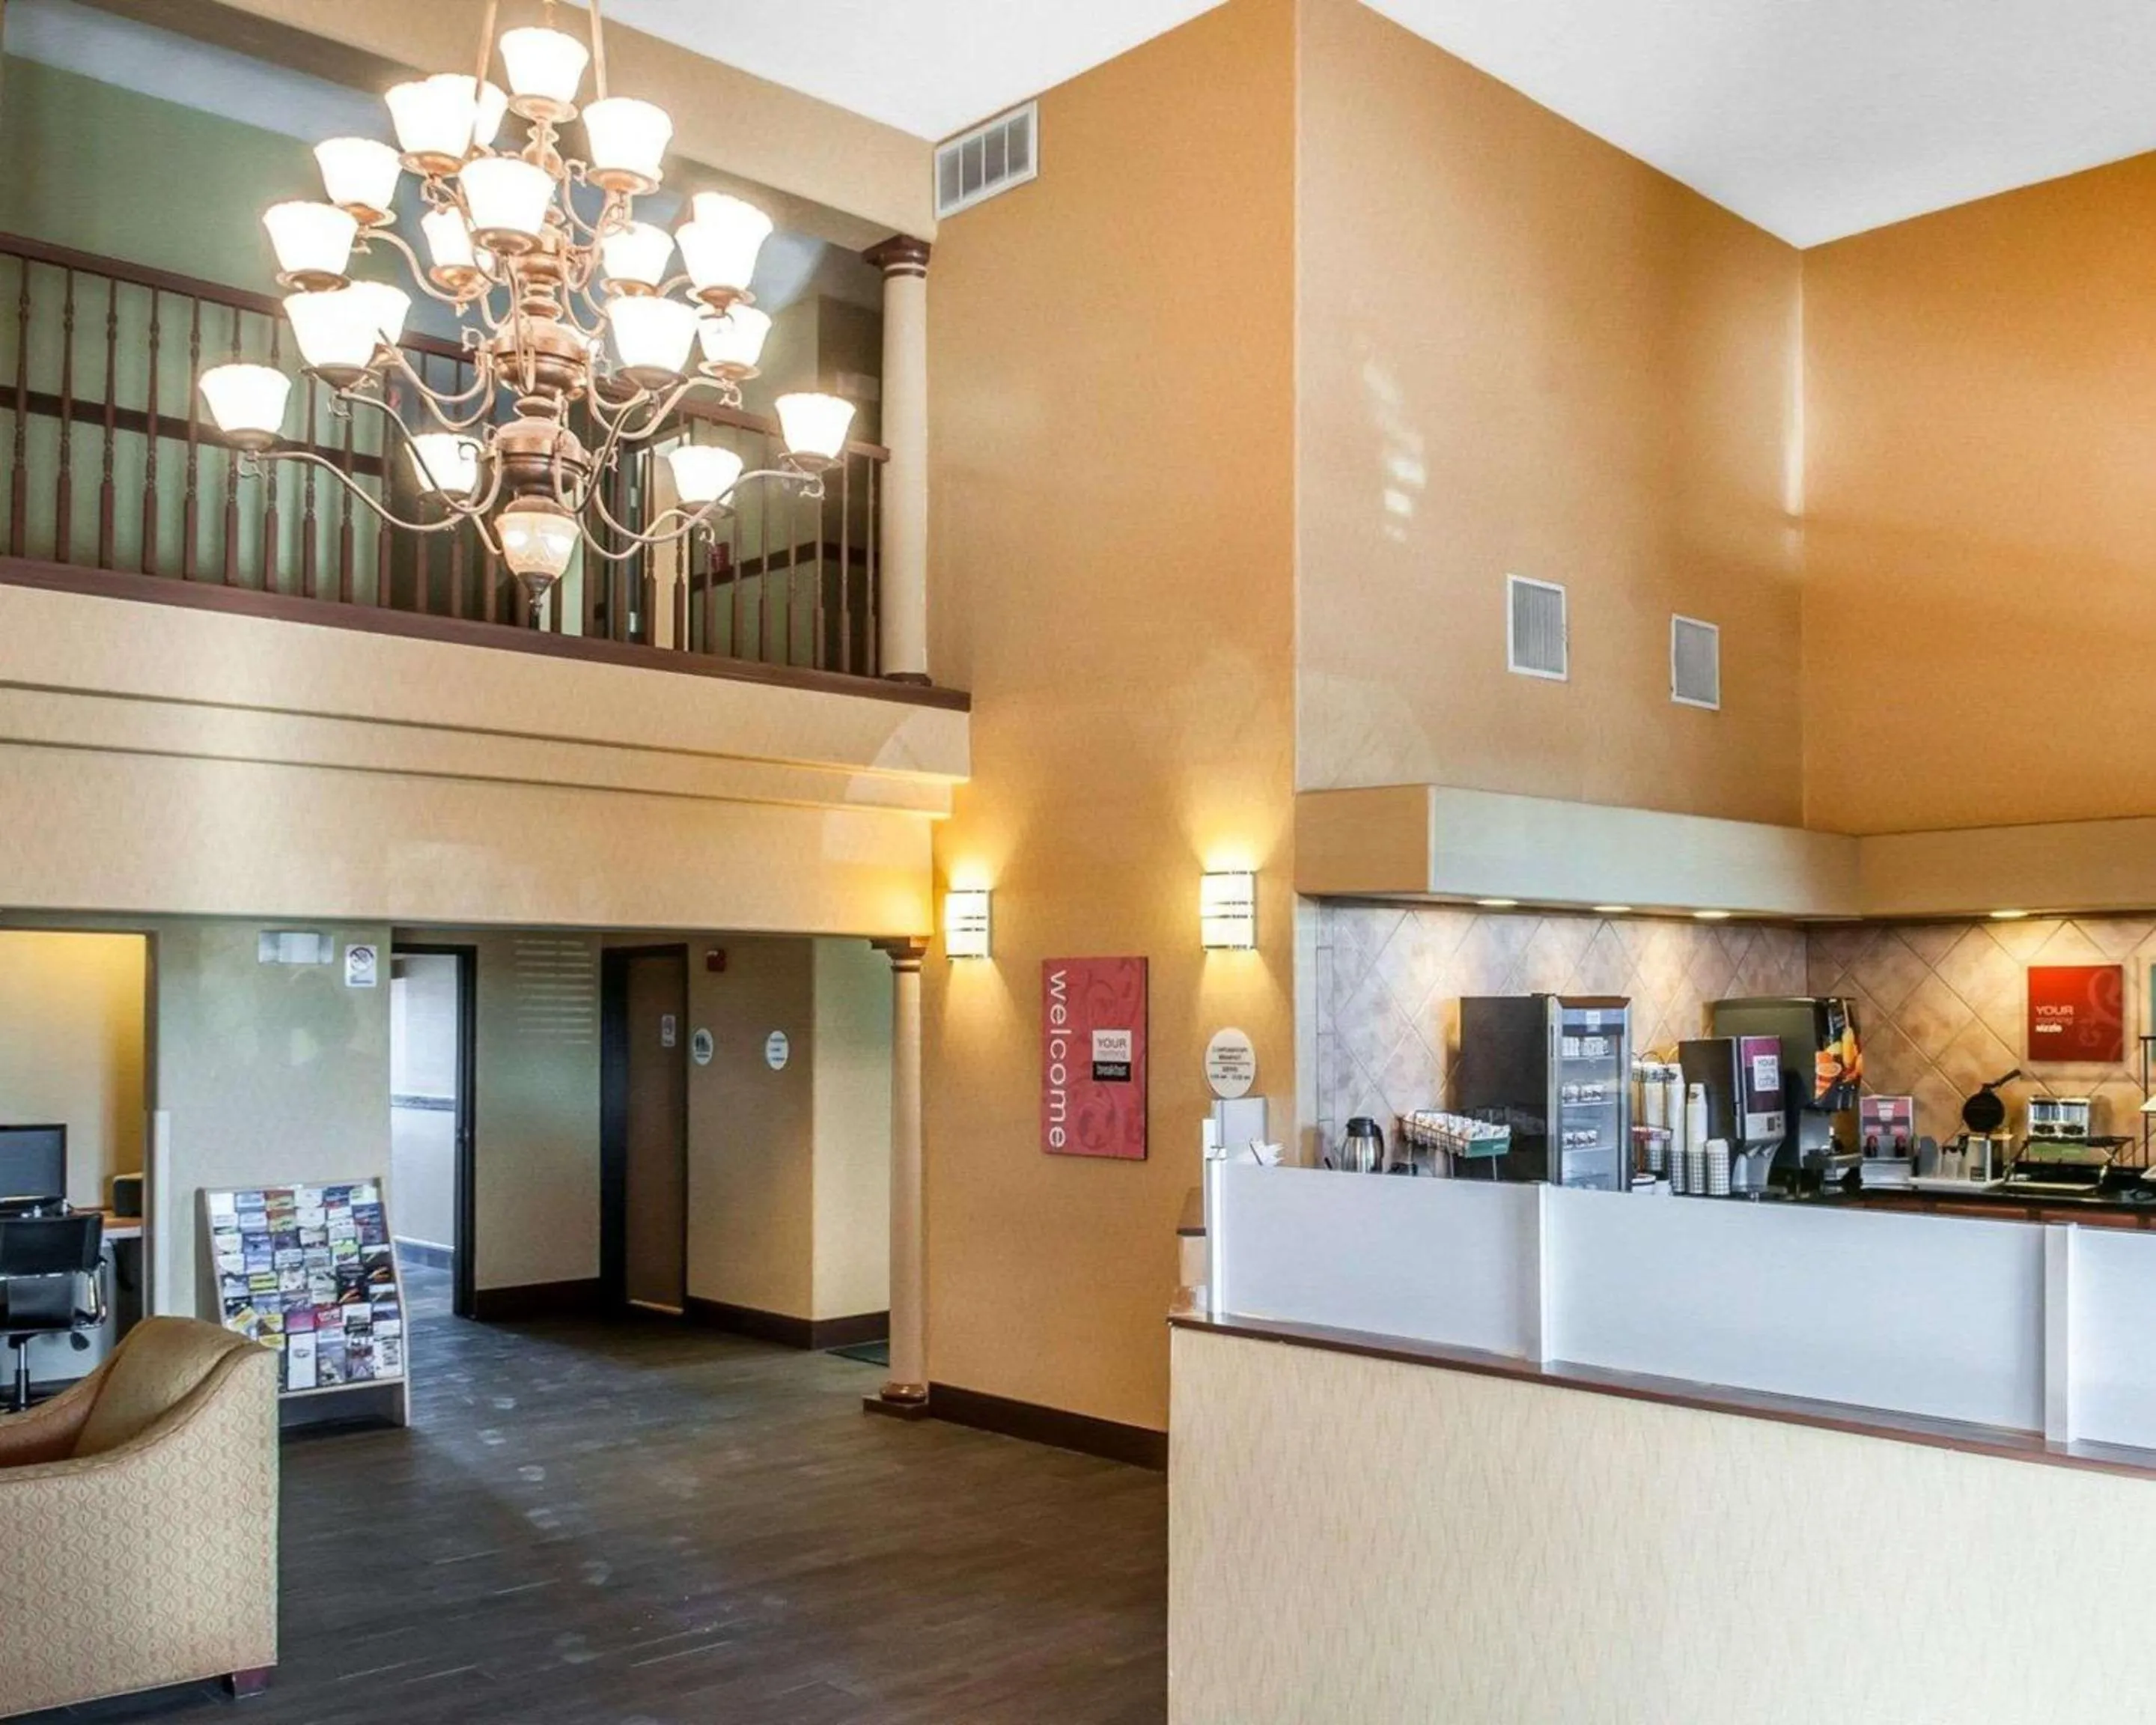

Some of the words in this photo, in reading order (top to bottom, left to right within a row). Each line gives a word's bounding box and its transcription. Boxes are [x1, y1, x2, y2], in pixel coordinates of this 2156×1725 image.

[2036, 1006, 2074, 1015] YOUR
[1097, 1038, 1127, 1048] YOUR
[1049, 970, 1072, 1148] welcome
